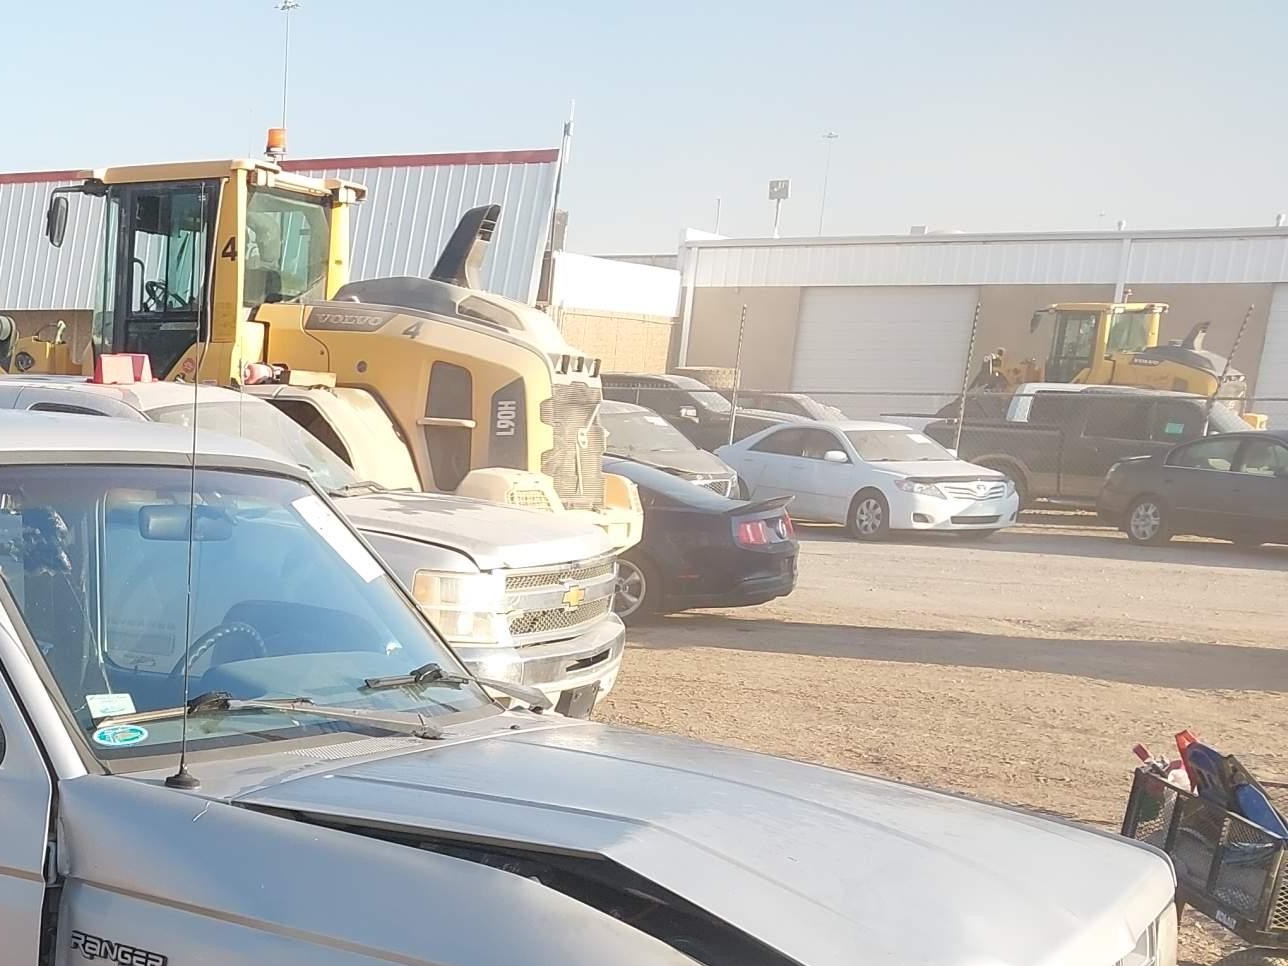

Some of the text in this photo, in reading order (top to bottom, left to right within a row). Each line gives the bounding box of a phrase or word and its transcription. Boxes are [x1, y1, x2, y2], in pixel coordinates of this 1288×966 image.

[220, 235, 238, 262] 4
[317, 312, 384, 326] VOLVO
[401, 319, 424, 340] 4
[495, 399, 517, 436] L90H
